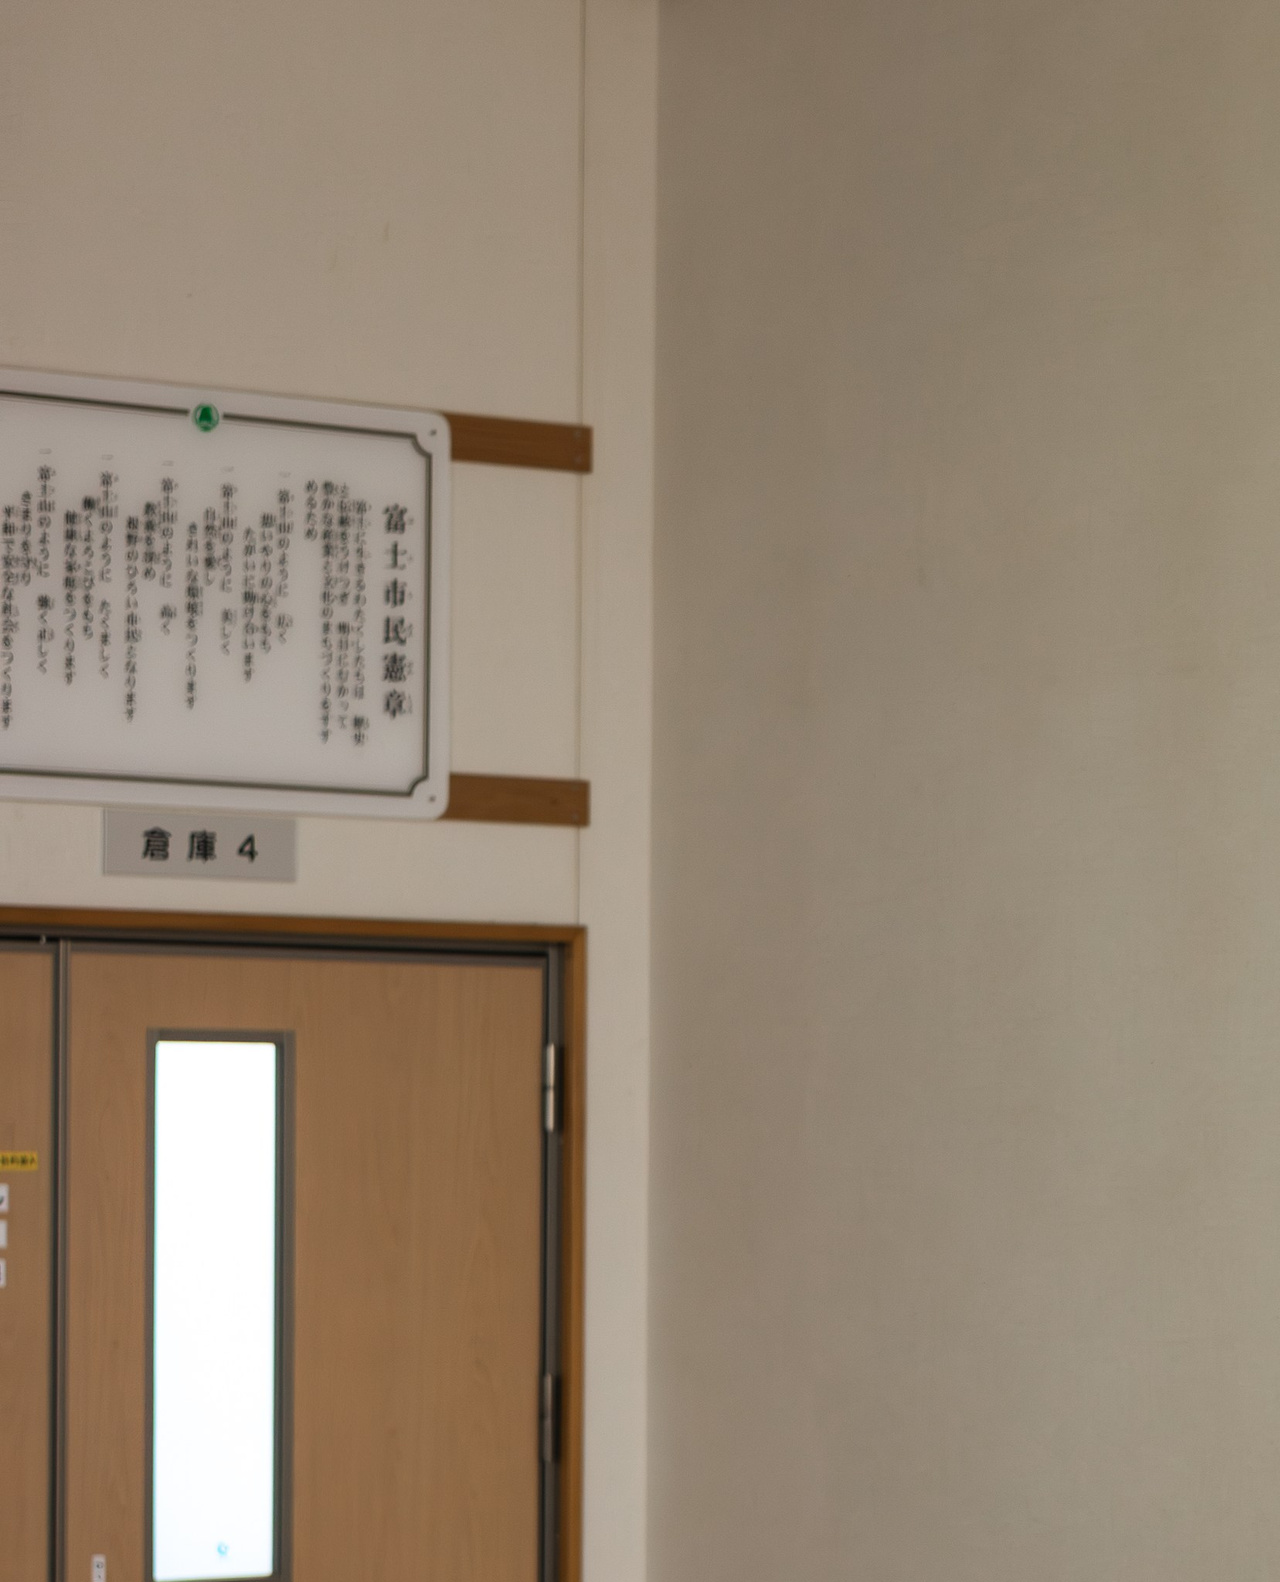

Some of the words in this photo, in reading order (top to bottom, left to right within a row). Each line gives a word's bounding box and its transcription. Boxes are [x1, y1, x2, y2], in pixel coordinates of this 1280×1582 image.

[382, 503, 407, 720] 富士市民憲章
